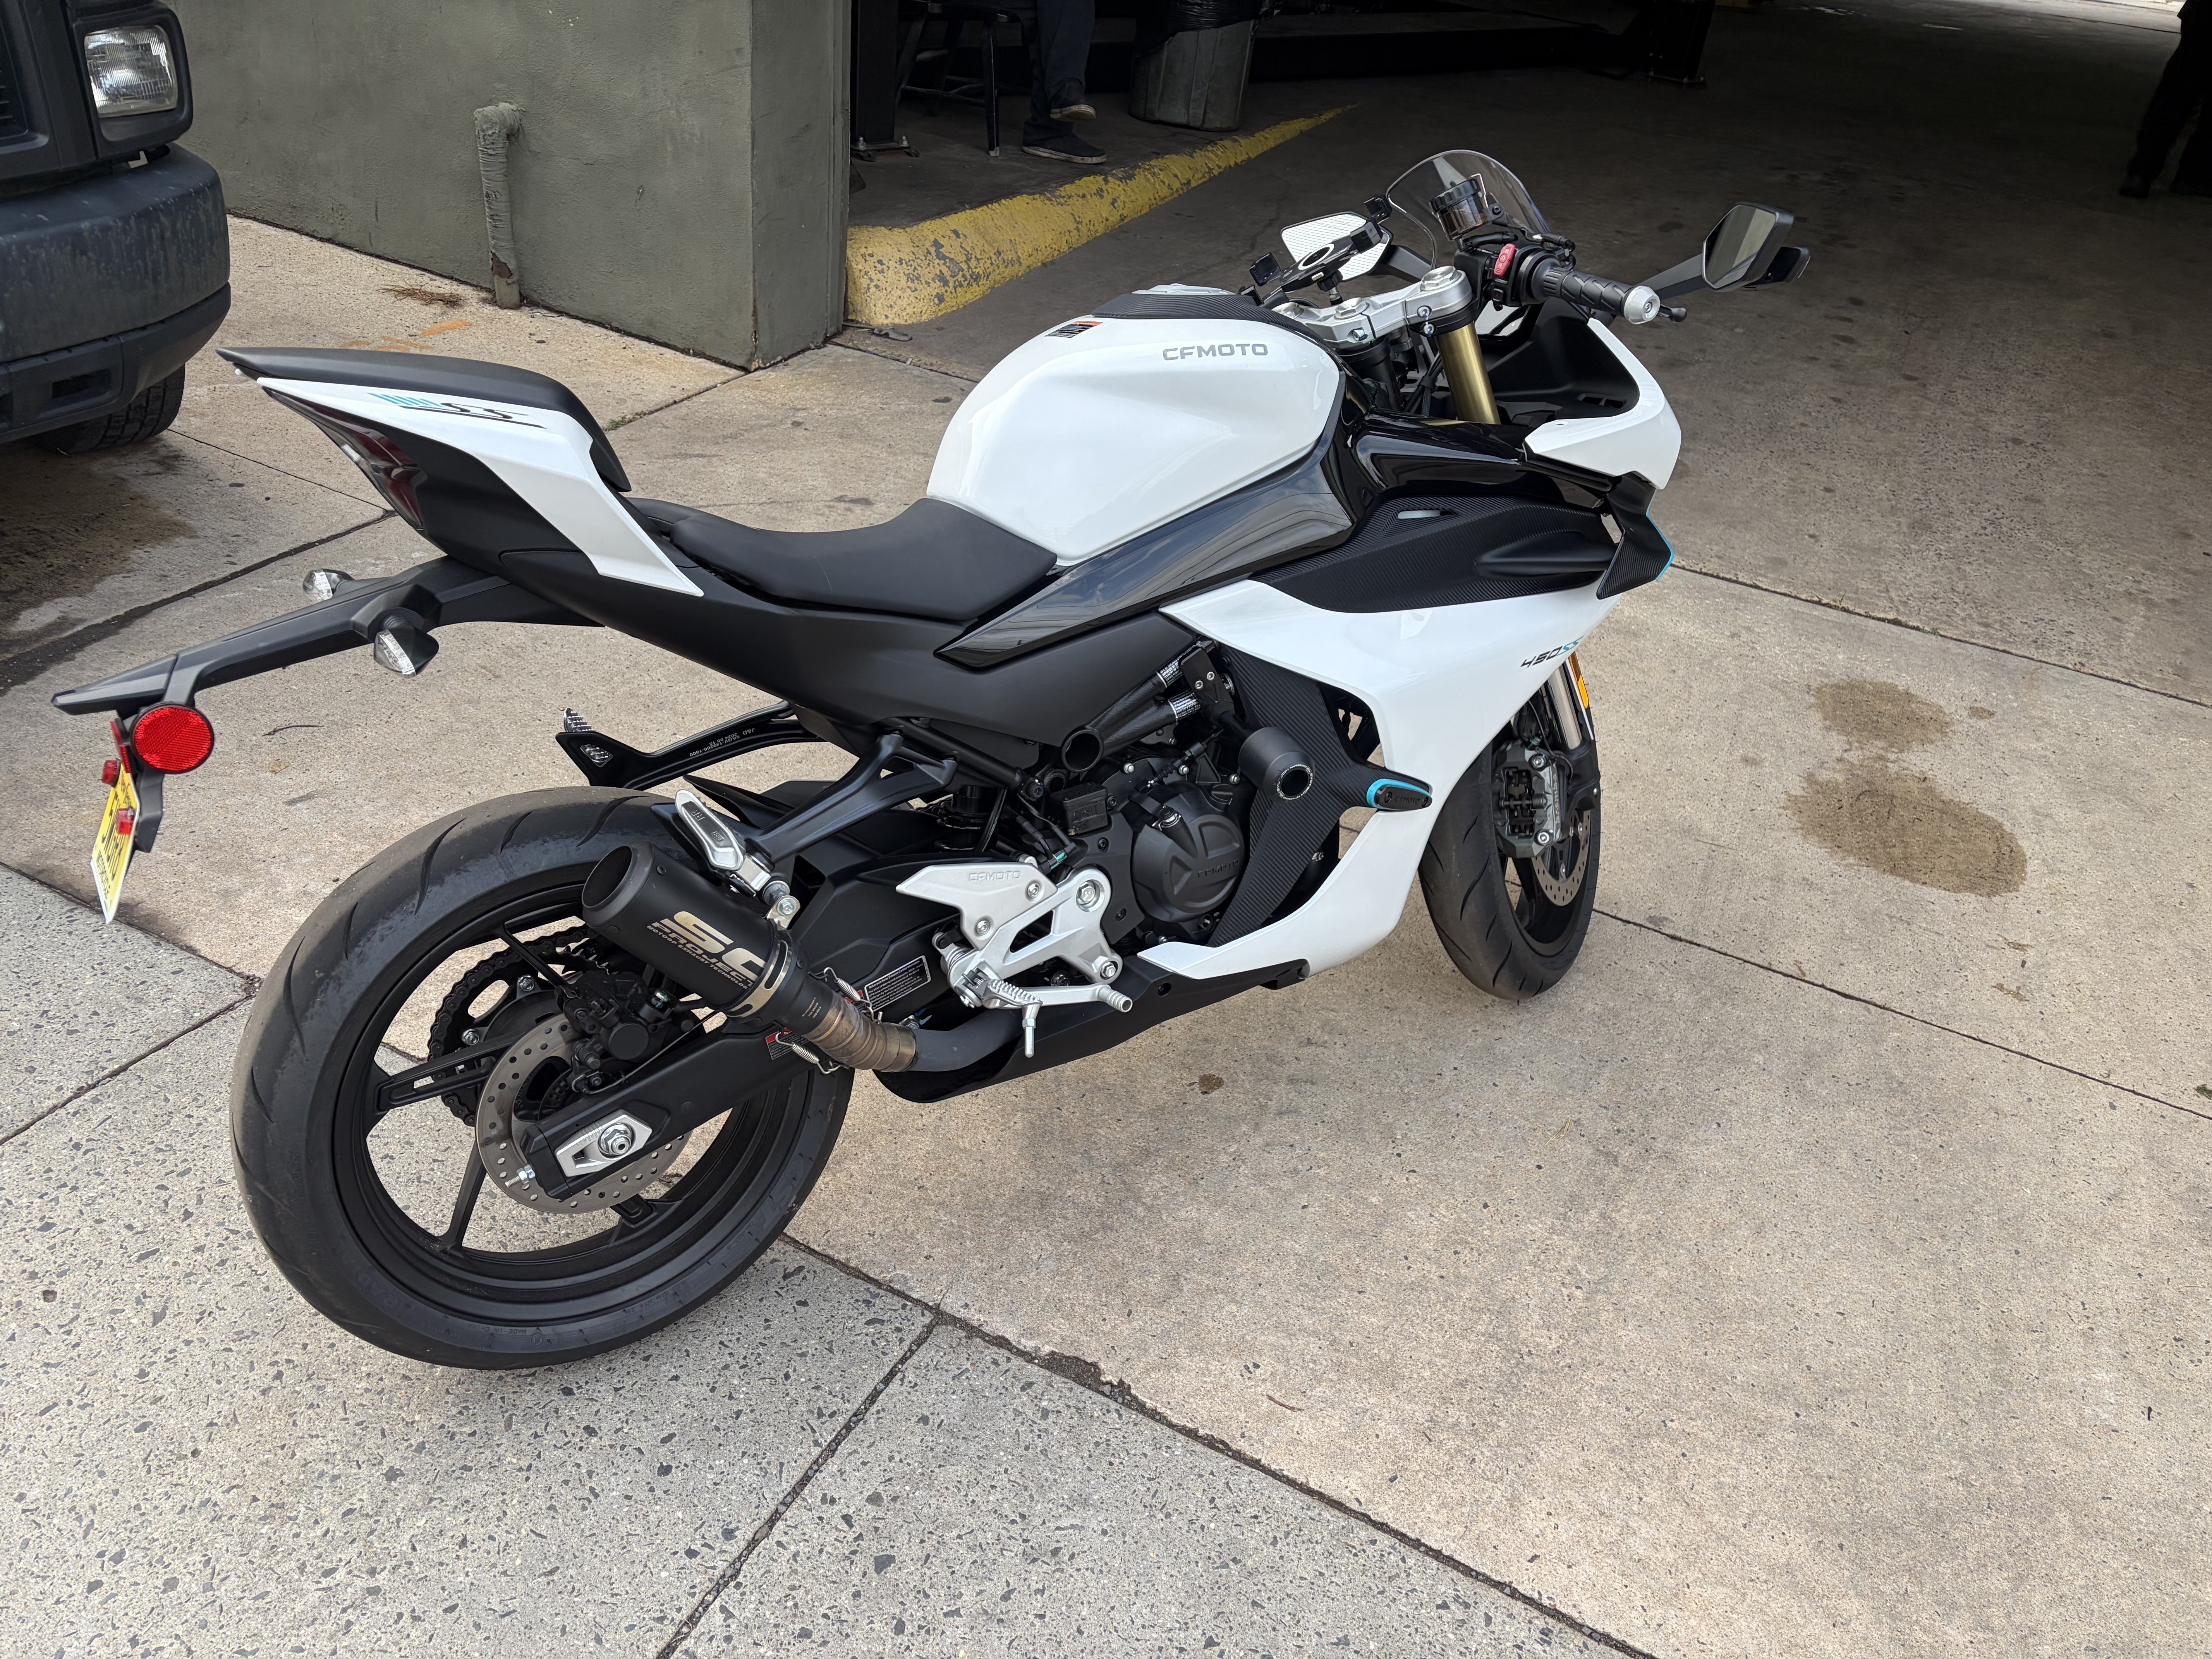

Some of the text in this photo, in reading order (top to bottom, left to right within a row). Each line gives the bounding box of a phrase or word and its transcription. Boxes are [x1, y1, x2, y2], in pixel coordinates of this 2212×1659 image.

[1163, 343, 1268, 361] CFMOTO
[742, 727, 756, 735] J&D
[968, 871, 1021, 882] CFMOTO
[647, 925, 748, 989] MOTOGP EXHAUST TECHNOLOG
